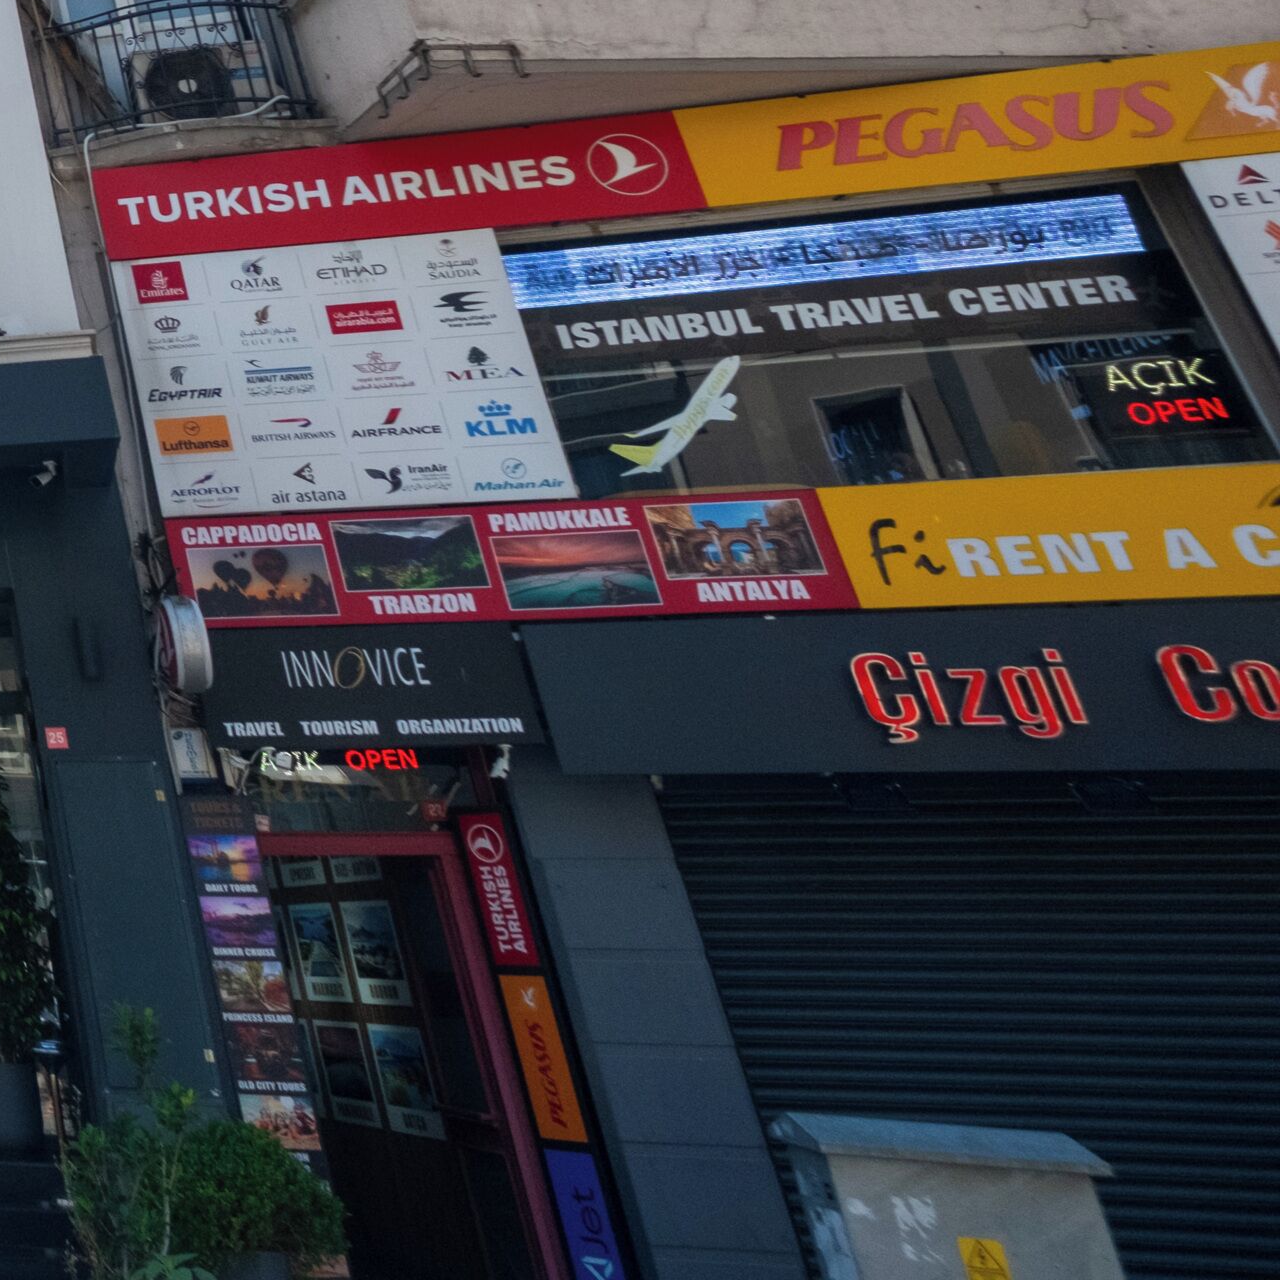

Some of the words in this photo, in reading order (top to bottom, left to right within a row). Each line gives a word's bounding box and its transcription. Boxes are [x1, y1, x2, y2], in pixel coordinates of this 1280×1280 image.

[777, 81, 1175, 172] PEGASUS
[118, 177, 331, 226] TURKISH
[342, 155, 576, 207] AIRLINES
[1208, 188, 1280, 210] DELT
[316, 264, 387, 280] ETIHAD
[429, 268, 481, 280] SAUDIA
[140, 287, 184, 298] Emirates
[230, 276, 281, 291] QATAR
[335, 315, 396, 327] airarabia.com
[555, 307, 763, 351] ISTANBUL
[769, 292, 940, 333] TRAVEL
[950, 274, 1137, 318] CENTER
[279, 336, 299, 344] AIR
[246, 374, 278, 384] KUWAIT
[279, 372, 314, 381] AIRWAYS
[446, 367, 527, 383] MEA
[1106, 357, 1216, 395] AÇIK
[1127, 397, 1230, 426] OPEN
[252, 432, 291, 443] BRITISH
[294, 430, 336, 440] AIRWAYS
[351, 425, 442, 439] AIRFRANCE
[465, 417, 538, 437] KLM
[162, 439, 229, 452] Lufthansa
[408, 464, 448, 474] IranAir
[170, 485, 241, 497] AEROFLOT
[474, 481, 538, 492] Mahan
[539, 478, 565, 489] Air
[272, 490, 290, 504] air
[296, 490, 346, 504] astana
[487, 507, 631, 534] PAMUKKALE
[182, 522, 322, 546] CAPPADOCIA
[946, 531, 1135, 578] RENT
[1163, 528, 1217, 569] A
[696, 579, 811, 602] ANTALYA
[368, 593, 476, 615] TRABZON
[280, 646, 432, 689] INNOVICE
[850, 648, 1089, 744] Çizgi
[1156, 644, 1280, 723] Co
[223, 721, 285, 738] TRAVEL
[300, 720, 379, 737] TOURISM
[397, 717, 524, 736] ORGANIZATION
[48, 733, 64, 743] 25
[259, 750, 324, 775] AIK
[345, 748, 419, 771] OPEN
[479, 866, 512, 953] TURKISH
[494, 865, 528, 954] AIRLINES
[222, 1012, 263, 1022] PRINCESS
[528, 1021, 568, 1128] PEGASUS
[256, 1080, 276, 1090] CITY
[276, 1082, 308, 1092] TOURS
